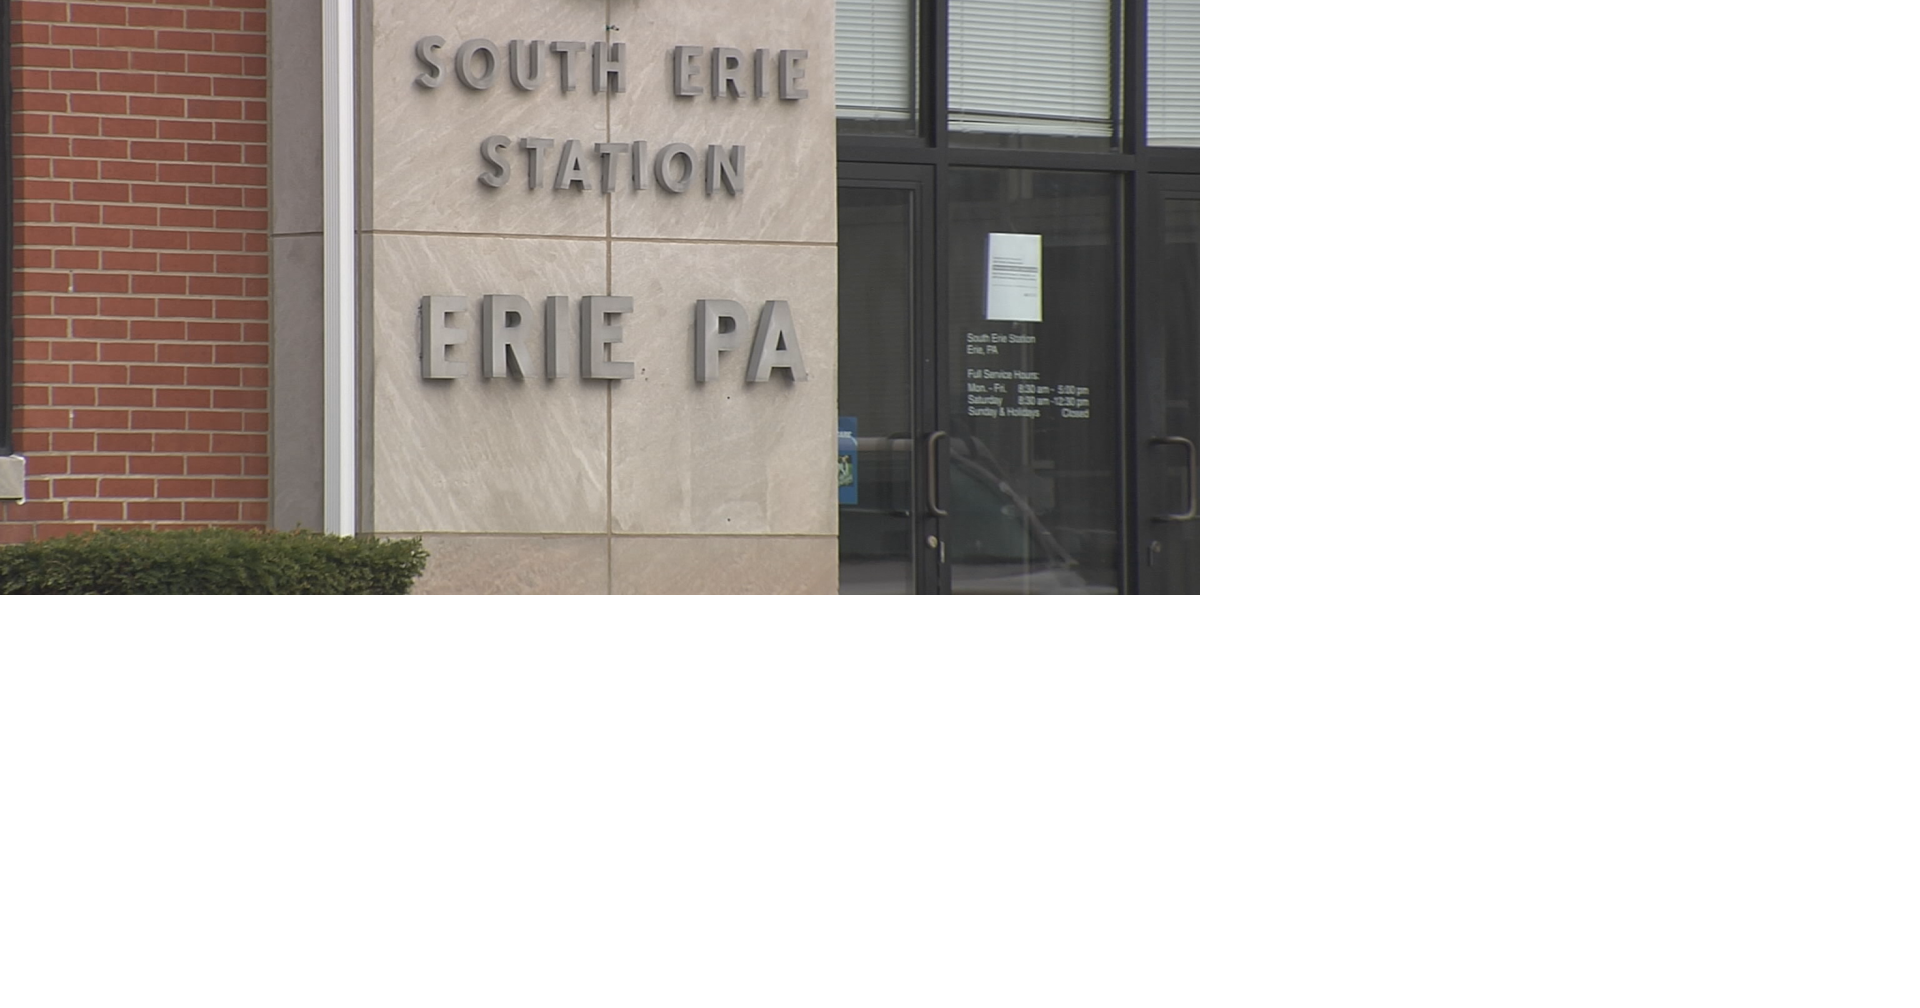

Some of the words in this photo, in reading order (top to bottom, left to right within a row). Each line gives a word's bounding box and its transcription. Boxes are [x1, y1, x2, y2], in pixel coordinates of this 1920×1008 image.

[414, 35, 626, 93] SOUTH
[673, 45, 809, 100] ERIE
[478, 135, 746, 195] STATION
[421, 294, 635, 380] ERIE
[694, 299, 808, 382] PA
[967, 333, 990, 343] South
[991, 333, 1007, 343] Erie
[1008, 333, 1036, 344] Station
[966, 345, 985, 355] Erie,
[986, 345, 999, 354] PA
[967, 368, 982, 379] Full
[983, 369, 1012, 380] Service
[1076, 387, 1089, 396] pm
[967, 394, 1003, 406] Saturday
[1076, 399, 1089, 408] pm
[967, 406, 998, 418] Sunday
[998, 407, 1006, 417] &
[1006, 407, 1041, 419] Holidays
[1061, 408, 1089, 418] Closed
